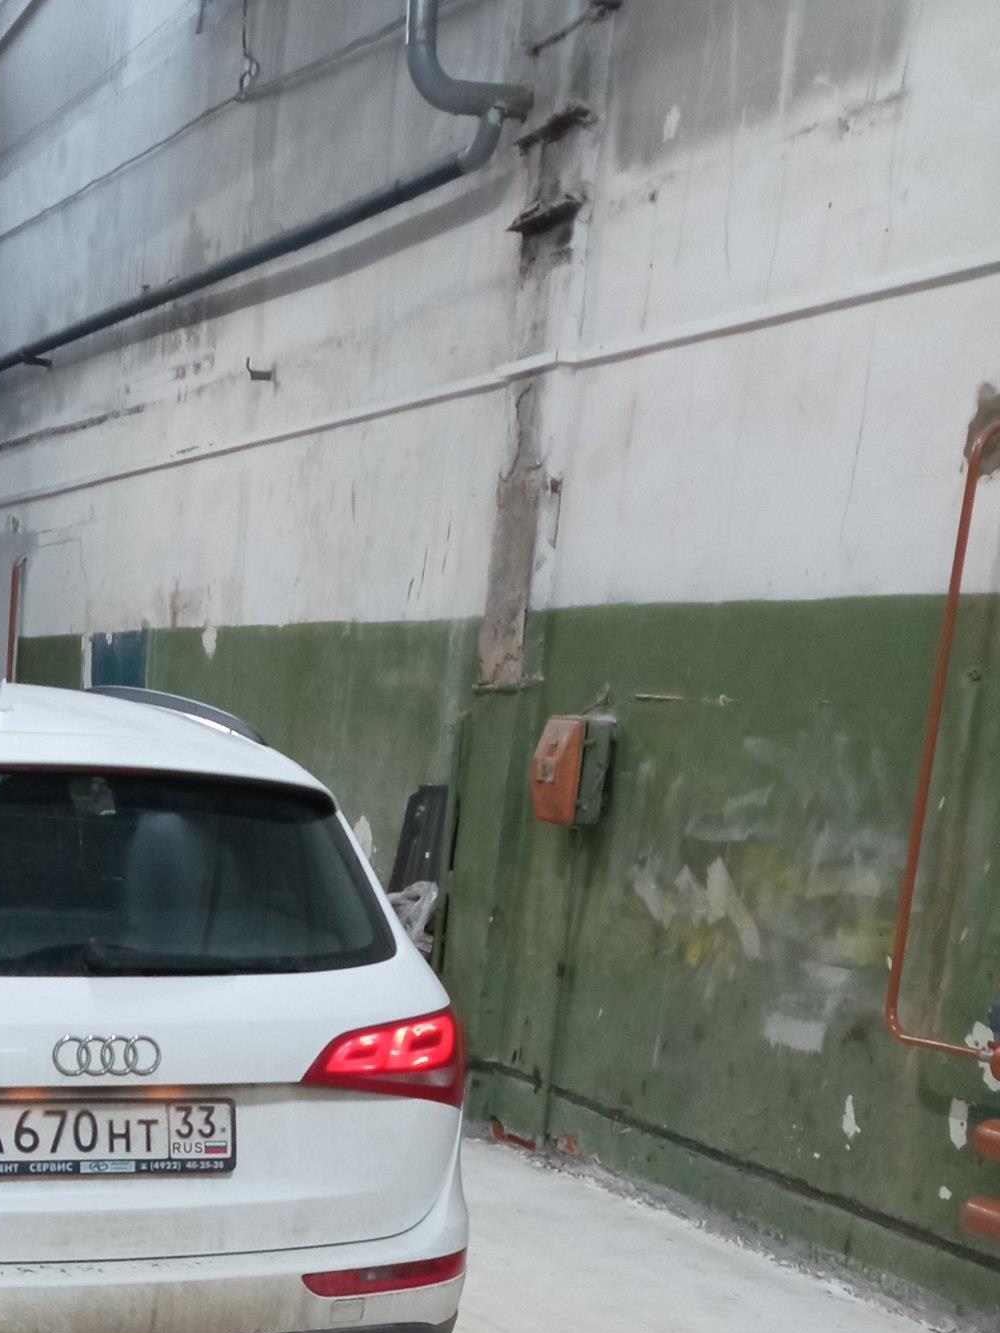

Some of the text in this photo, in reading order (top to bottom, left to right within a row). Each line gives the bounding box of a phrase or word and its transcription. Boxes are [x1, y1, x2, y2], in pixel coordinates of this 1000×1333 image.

[175, 1105, 216, 1139] 33
[172, 1142, 203, 1154] RUS
[29, 1162, 73, 1172] СЕРВИС
[150, 1161, 181, 1171] (4922)
